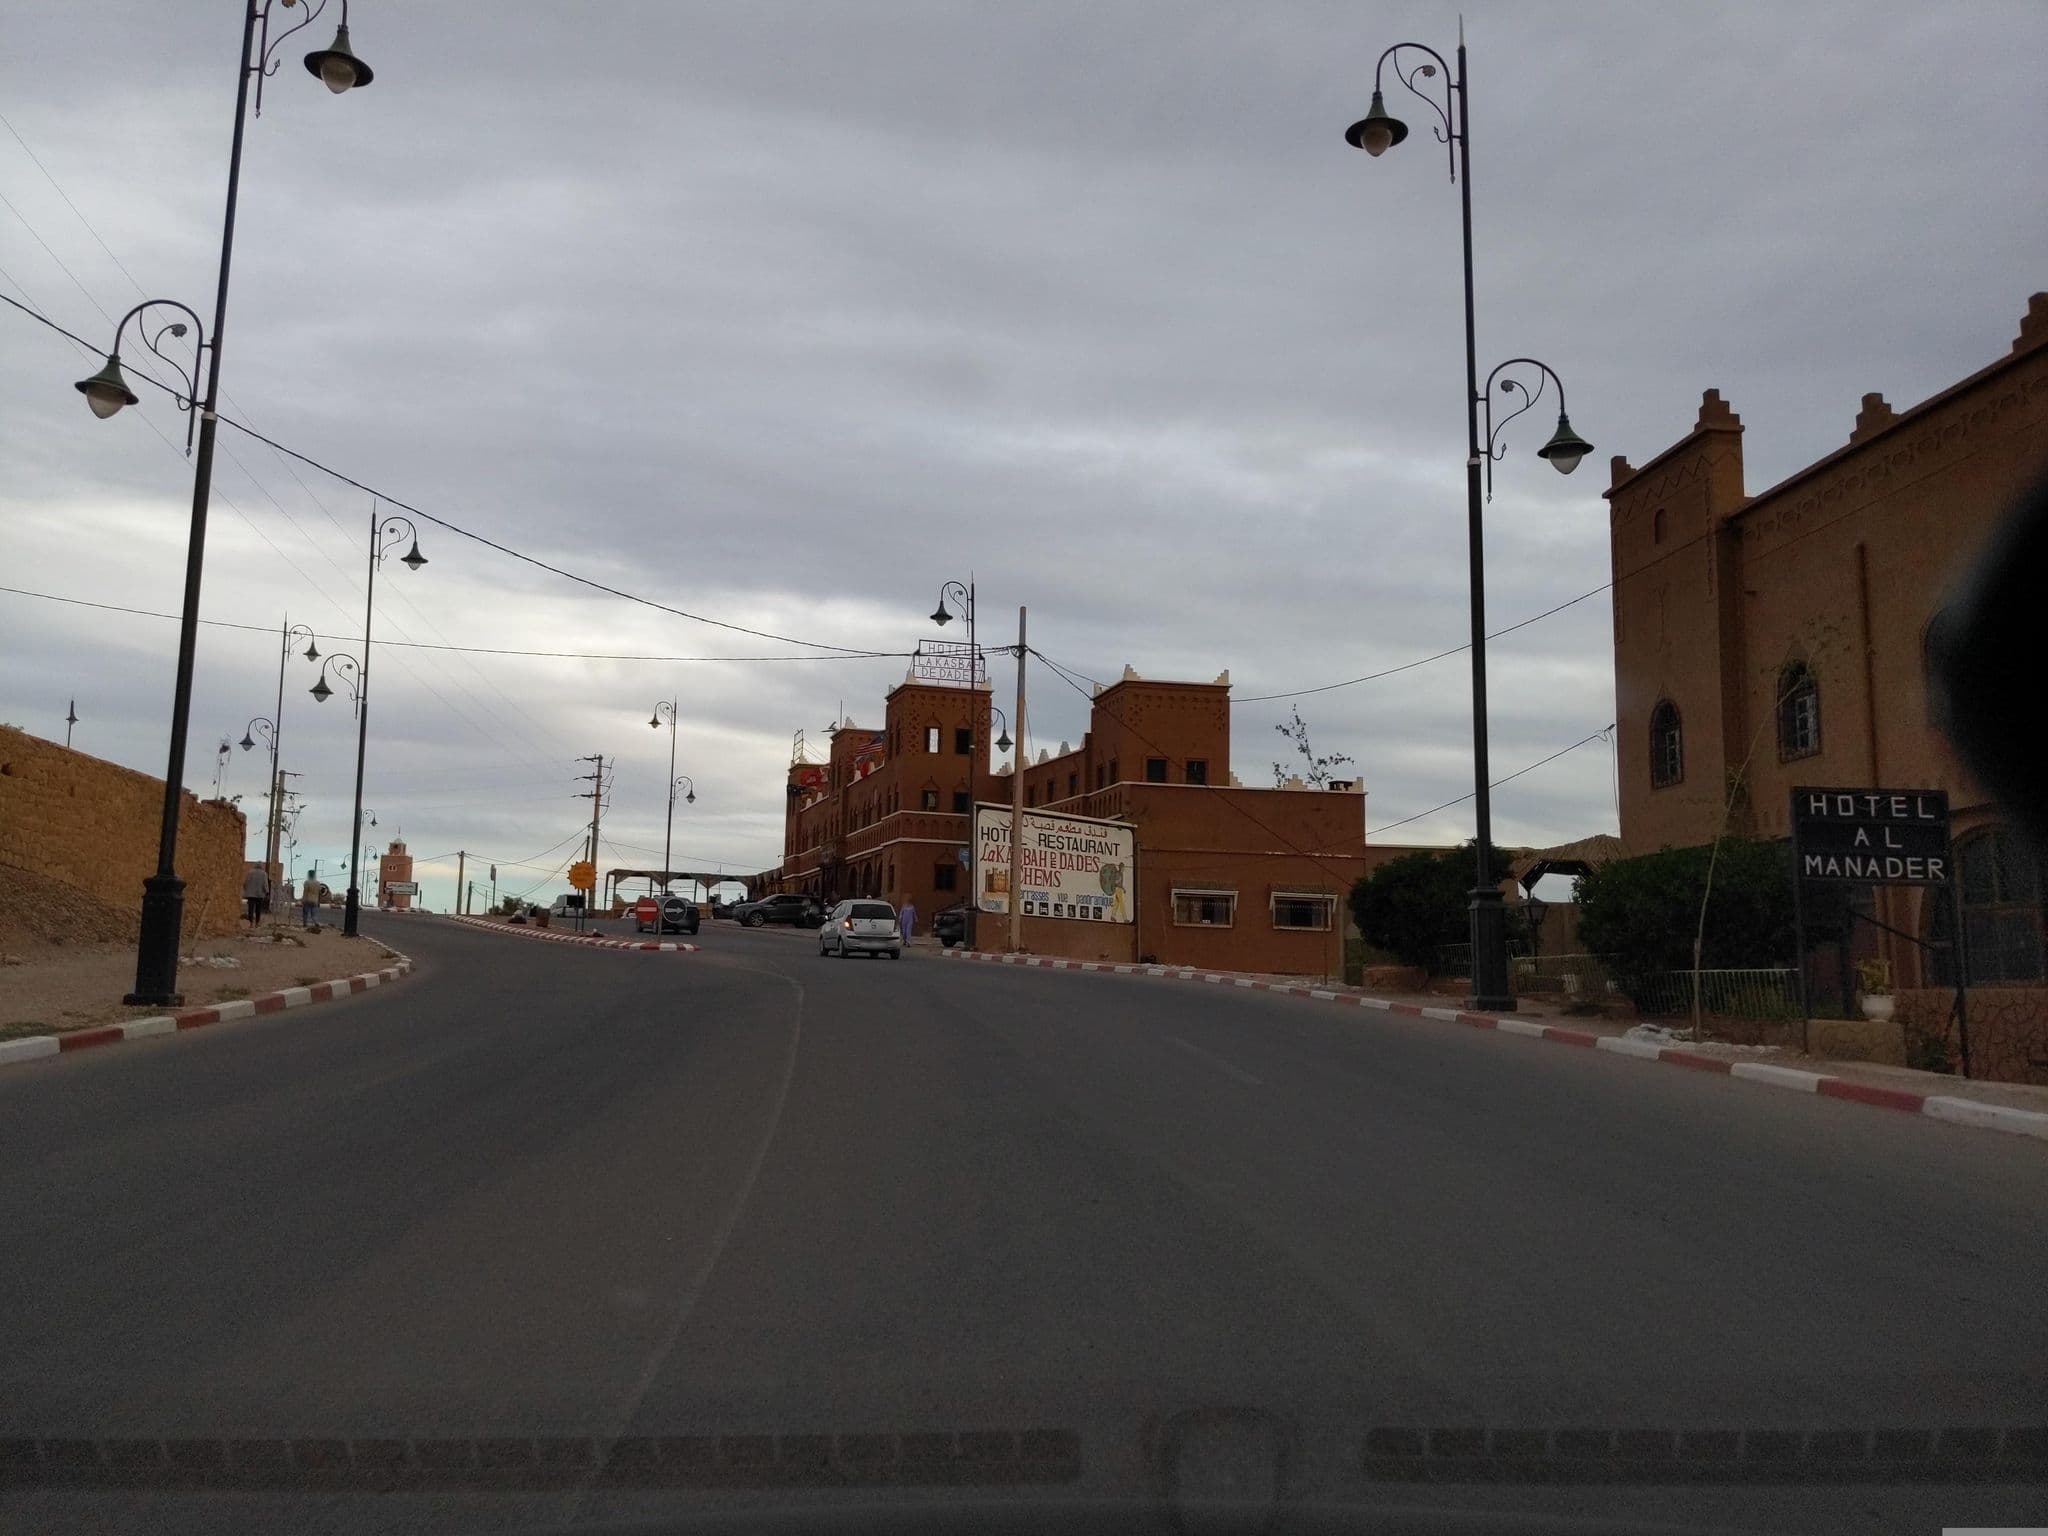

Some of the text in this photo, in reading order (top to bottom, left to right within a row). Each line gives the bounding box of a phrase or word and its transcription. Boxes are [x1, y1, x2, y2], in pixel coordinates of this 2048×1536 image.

[928, 643, 970, 656] HOTEL
[918, 655, 981, 670] LA KASBAH
[922, 667, 936, 678] DE
[1810, 794, 1935, 818] HOTEL
[1031, 816, 1056, 832] قصبة
[1056, 821, 1082, 834] مطعم
[1084, 825, 1108, 839] فندق
[1038, 833, 1121, 856] RESTAURANT
[1854, 826, 1902, 848] AL
[1059, 852, 1100, 873] DADES
[1805, 855, 1945, 879] MANADER
